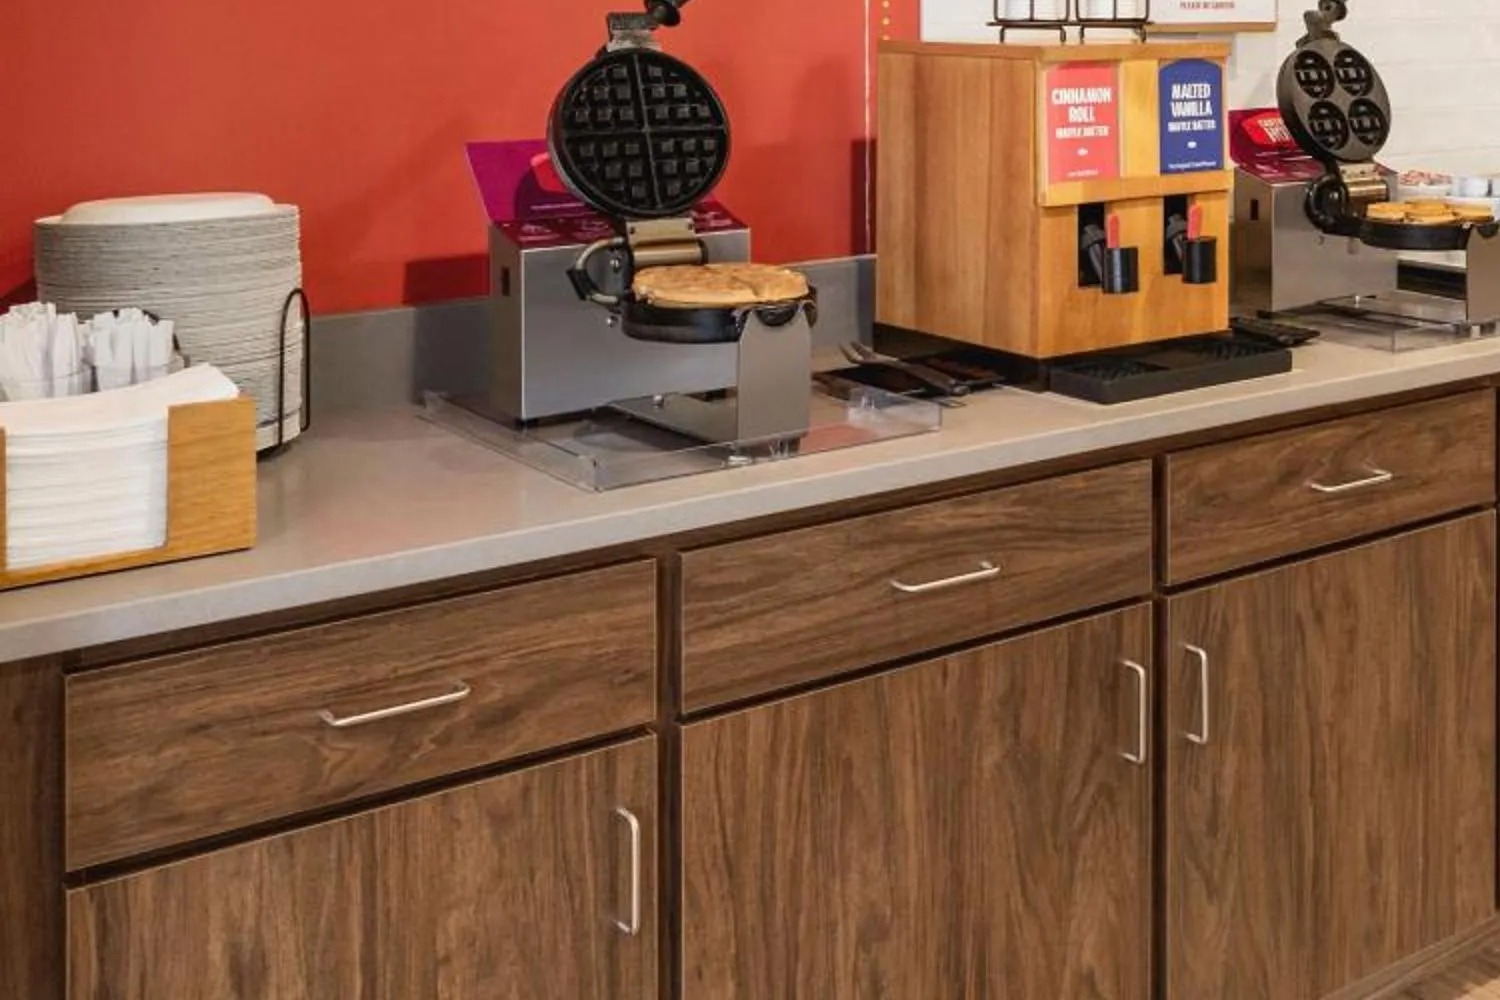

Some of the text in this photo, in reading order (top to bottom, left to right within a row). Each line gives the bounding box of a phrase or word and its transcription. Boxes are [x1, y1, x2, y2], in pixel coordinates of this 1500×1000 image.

[1051, 87, 1112, 105] CINNAMON
[1171, 83, 1211, 100] MALTED
[1068, 106, 1096, 122] ROLL
[1171, 100, 1213, 117] VANILLA
